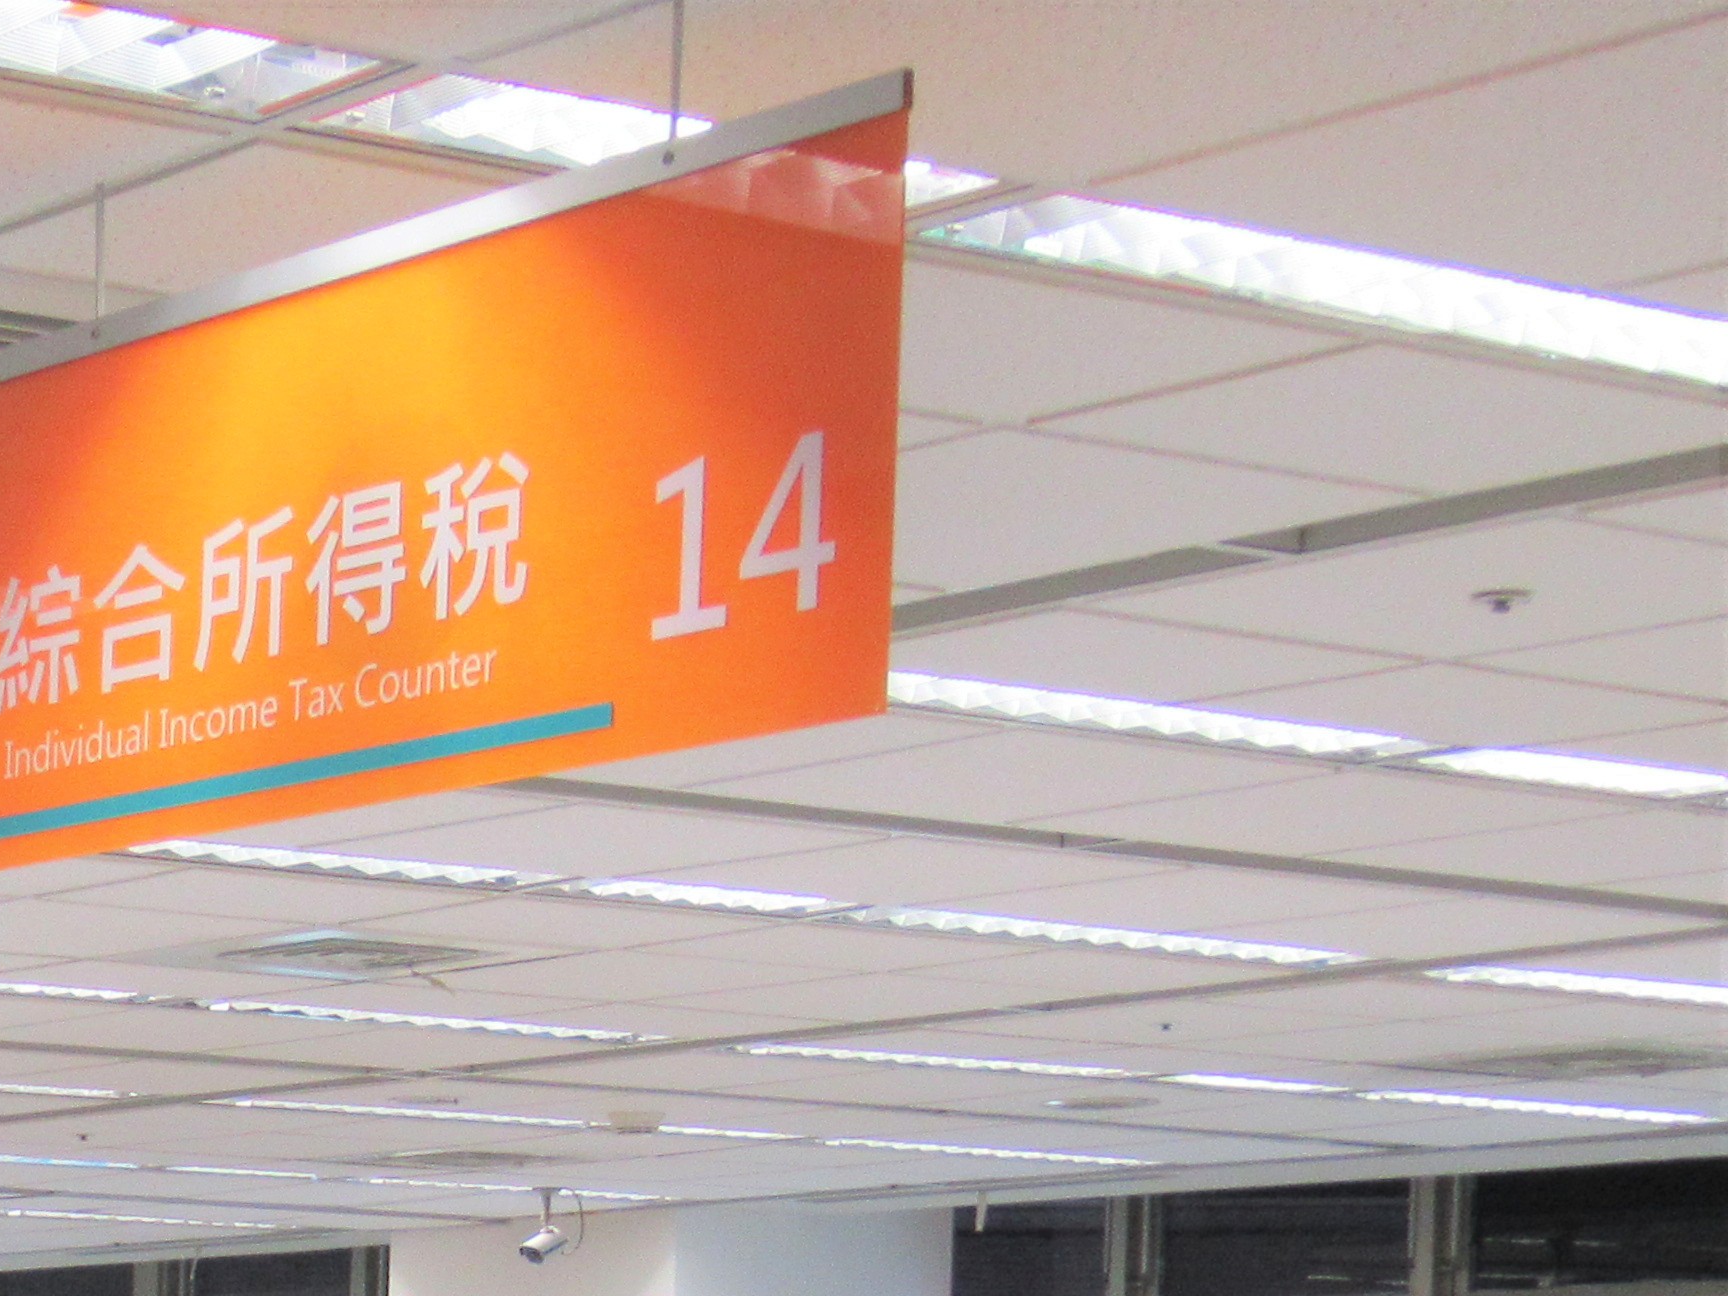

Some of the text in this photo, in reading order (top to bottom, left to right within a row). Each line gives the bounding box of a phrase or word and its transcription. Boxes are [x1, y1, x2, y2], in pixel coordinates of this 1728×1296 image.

[650, 430, 836, 640] 14
[3, 649, 497, 779] Individual Income Tax Counter
